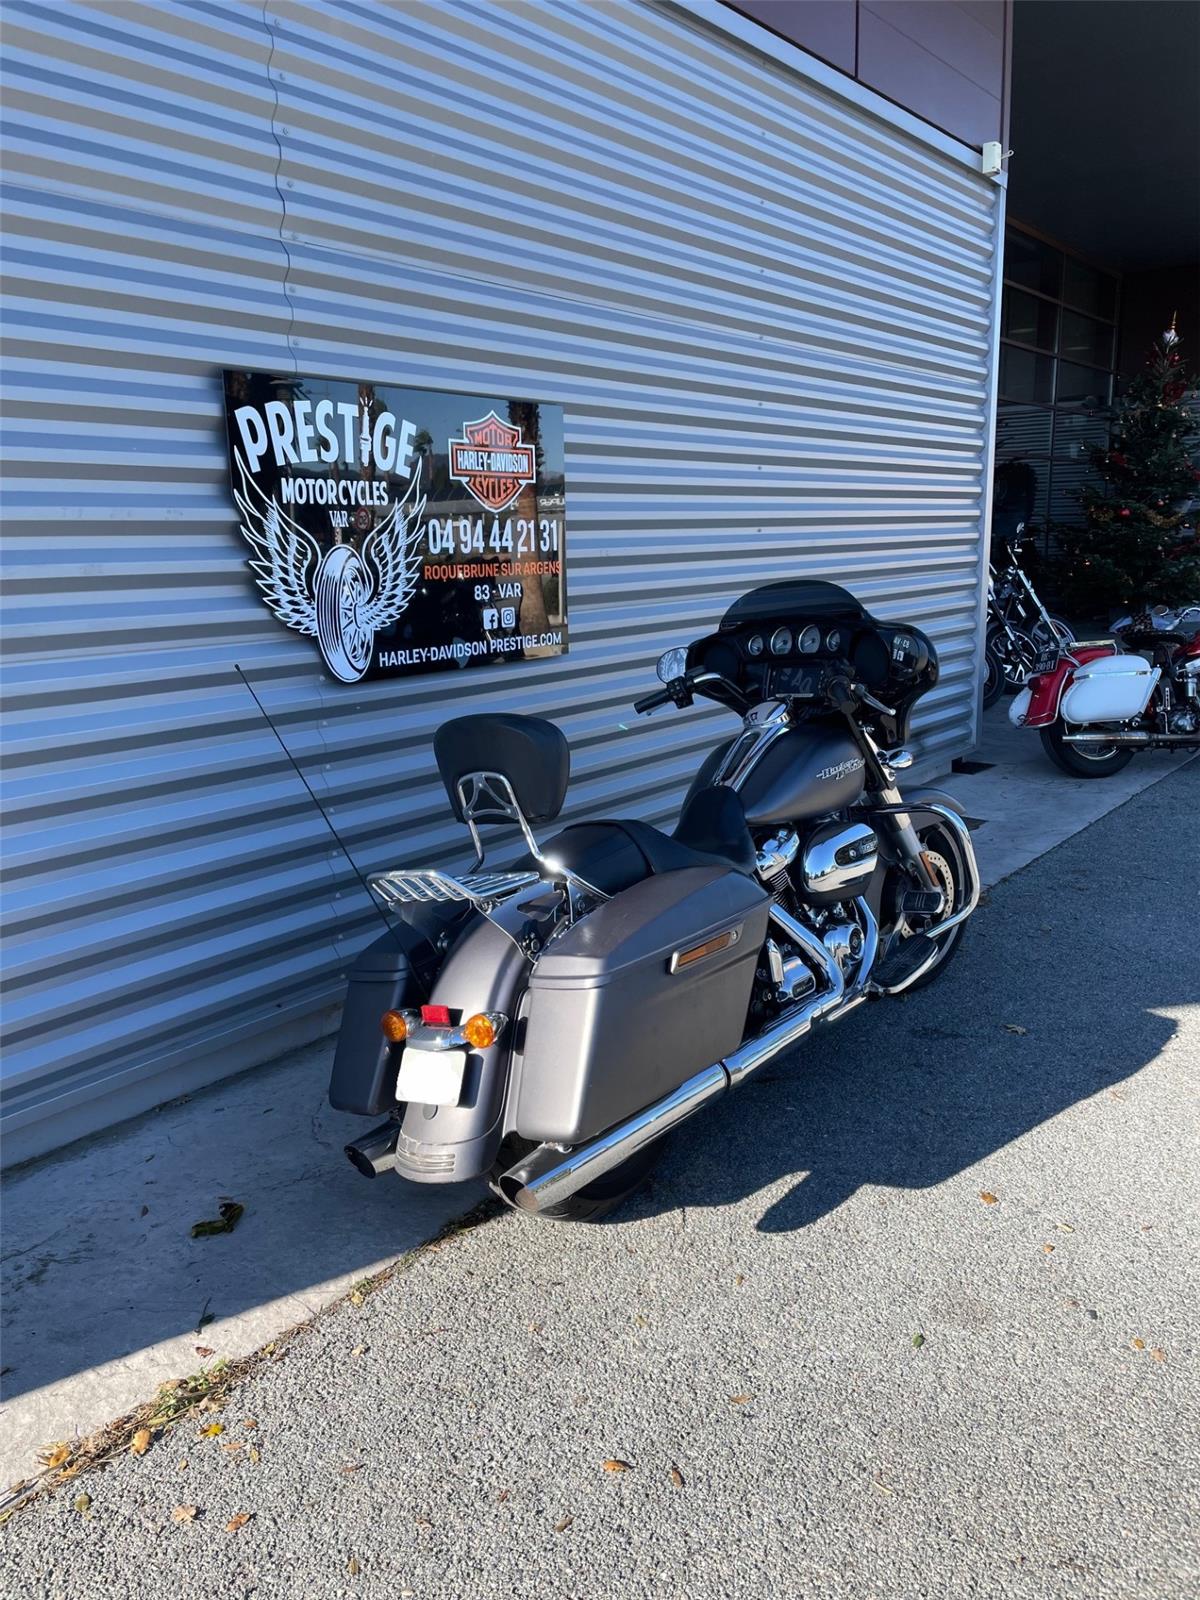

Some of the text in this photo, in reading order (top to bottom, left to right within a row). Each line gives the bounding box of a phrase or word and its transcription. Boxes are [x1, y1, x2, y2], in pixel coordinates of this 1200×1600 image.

[234, 398, 417, 479] PRESTIGE
[474, 424, 513, 446] MOTOR
[457, 450, 529, 473] HARLEY-DAVIDSON
[281, 477, 389, 506] MOTORCYCLES
[475, 475, 514, 503] CYCLES
[329, 510, 350, 528] VAR
[428, 519, 558, 555] 04 94 44 21 31
[424, 560, 561, 582] ROQUEBRUNE SUR ARGENS
[474, 585, 490, 600] 83
[498, 583, 522, 598] VAR
[379, 632, 562, 667] HARLEY-DAVIDSON PRESTIGE.COM
